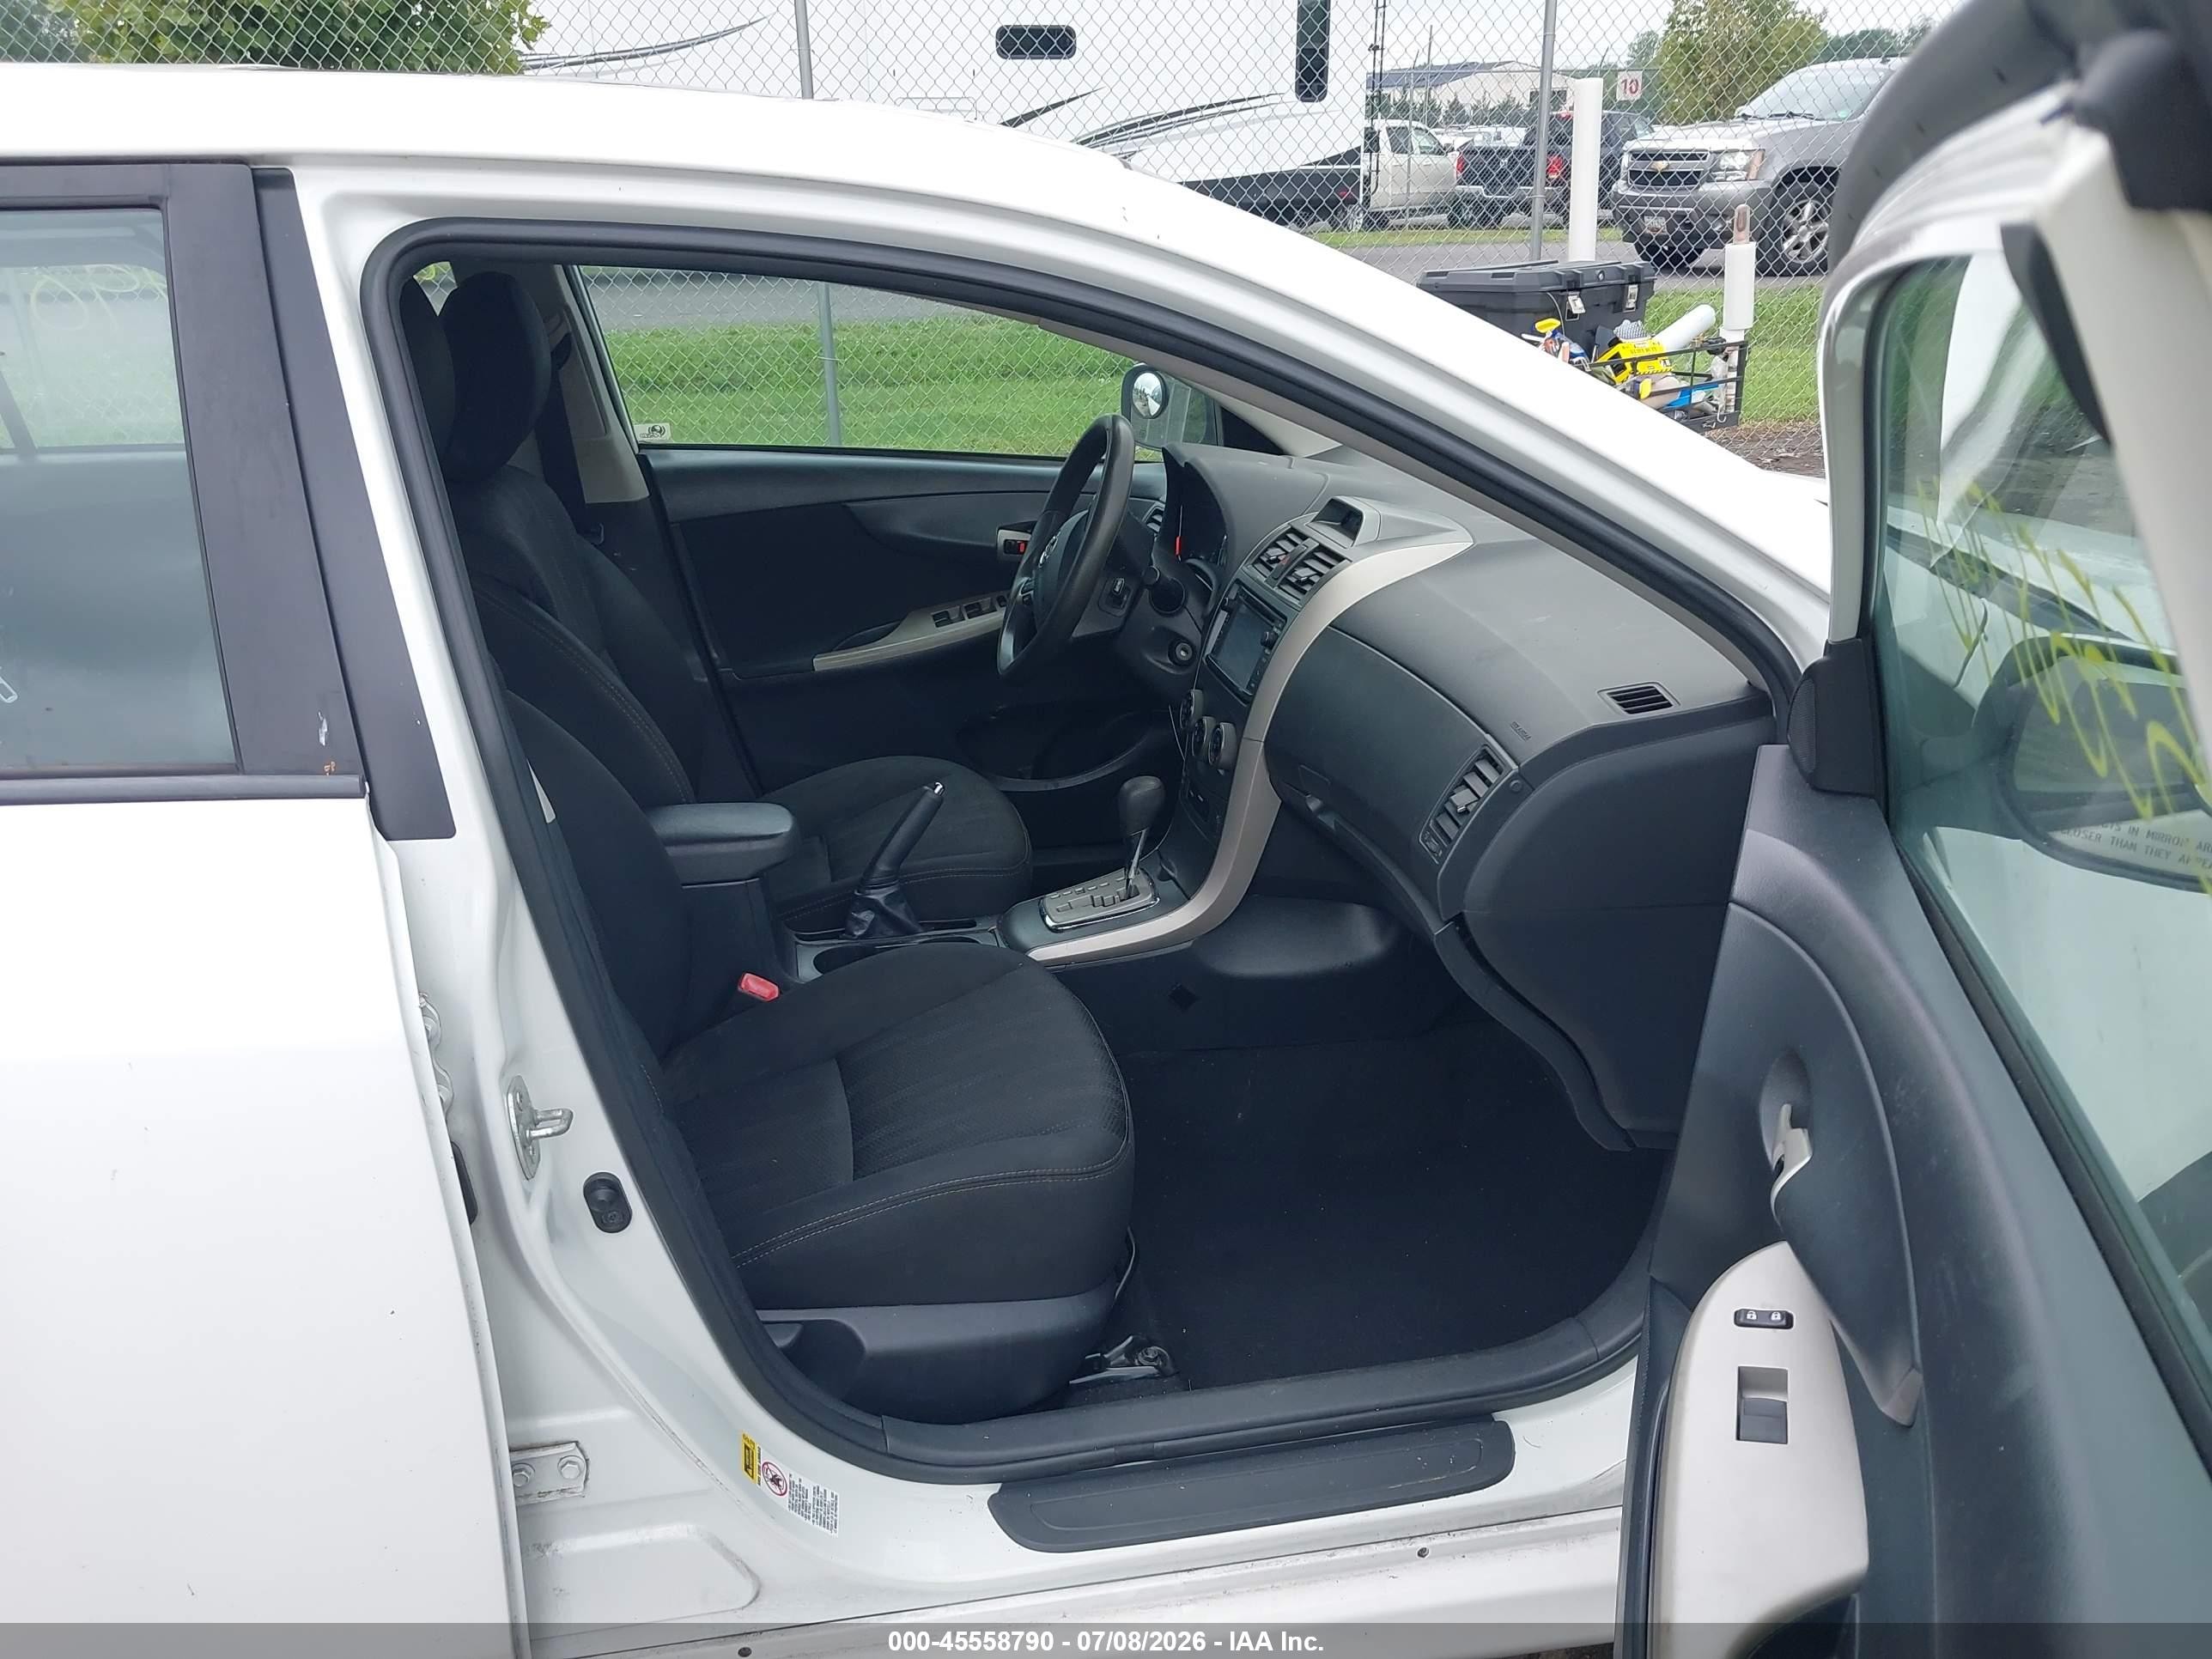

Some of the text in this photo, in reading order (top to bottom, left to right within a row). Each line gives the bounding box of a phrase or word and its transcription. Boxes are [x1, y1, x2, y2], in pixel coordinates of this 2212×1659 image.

[1620, 78, 1639, 94] 10
[2128, 824, 2140, 837] IN
[2110, 836, 2137, 853] THAN
[2144, 845, 2172, 860] THEY
